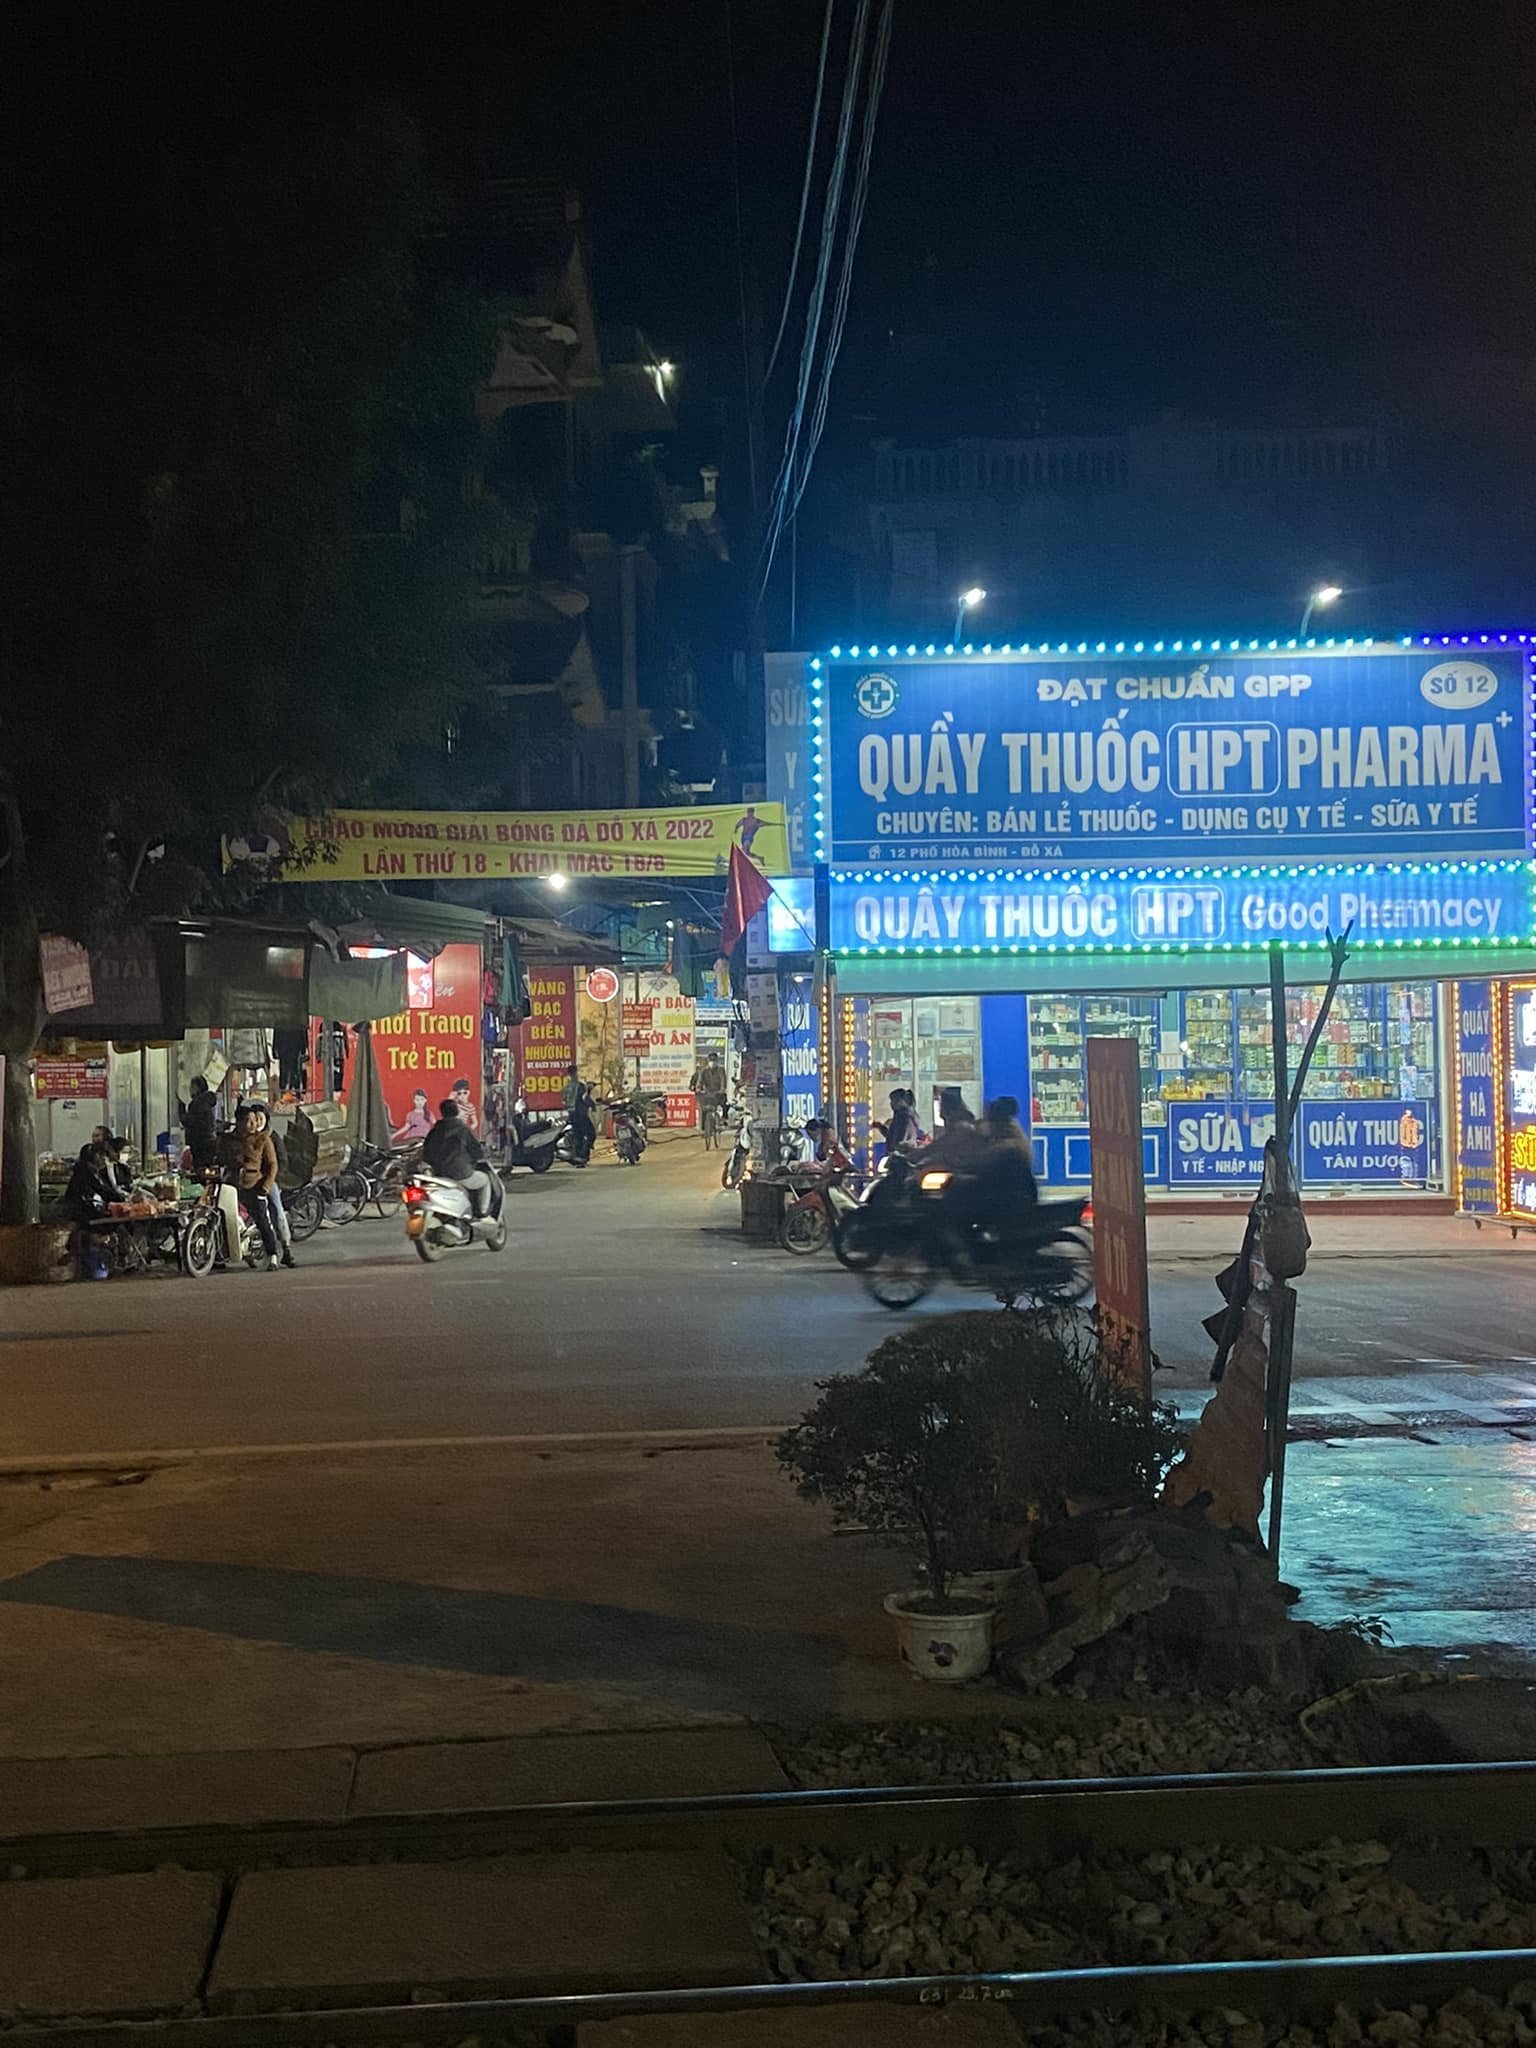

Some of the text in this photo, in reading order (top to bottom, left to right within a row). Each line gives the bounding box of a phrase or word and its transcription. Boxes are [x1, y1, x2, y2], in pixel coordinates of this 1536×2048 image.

[1037, 664, 1312, 707] ĐẠT CHUẨN GPP
[1429, 669, 1489, 694] SỐ 12
[858, 711, 986, 803] QUẦY
[1001, 707, 1160, 795] THUỐC
[1177, 728, 1271, 793] HPT
[876, 806, 979, 835] CHUYÊN:
[986, 806, 1037, 834] BÁN
[1043, 800, 1072, 833] LẺ
[1078, 801, 1158, 833] THUỐC
[1182, 806, 1249, 836] DỤNG
[1255, 806, 1289, 834] CỤ
[1296, 805, 1313, 829] Y
[1317, 797, 1347, 828] TẾ
[1370, 798, 1421, 828] SỮA
[1427, 802, 1443, 826] Y
[1448, 793, 1480, 825] TẾ
[496, 819, 554, 842] BÓNG
[665, 818, 714, 840] 2022
[363, 845, 407, 875] LẦN
[413, 847, 456, 874] THỨ
[462, 853, 488, 874] 18
[509, 852, 558, 873] KHAI
[889, 848, 907, 859] 12
[854, 882, 965, 944] QUẦY
[979, 880, 1117, 939] THUỐC
[1140, 891, 1220, 938] HPT
[1241, 892, 1329, 930] Good
[1340, 891, 1502, 934] Pharmacy
[528, 978, 566, 996] VÀNG
[533, 1000, 561, 1018] BẠC
[417, 1011, 474, 1040] Trang
[388, 1043, 456, 1071] Trẻ Em
[1178, 1112, 1243, 1154] SỮA
[1309, 1112, 1358, 1150] QUẦY
[1466, 1125, 1491, 1152] ANH
[1182, 1160, 1189, 1173] Y
[1190, 1158, 1206, 1174] TẾ
[1215, 1158, 1246, 1177] NHẬP
[1323, 1153, 1357, 1170] TÂN
